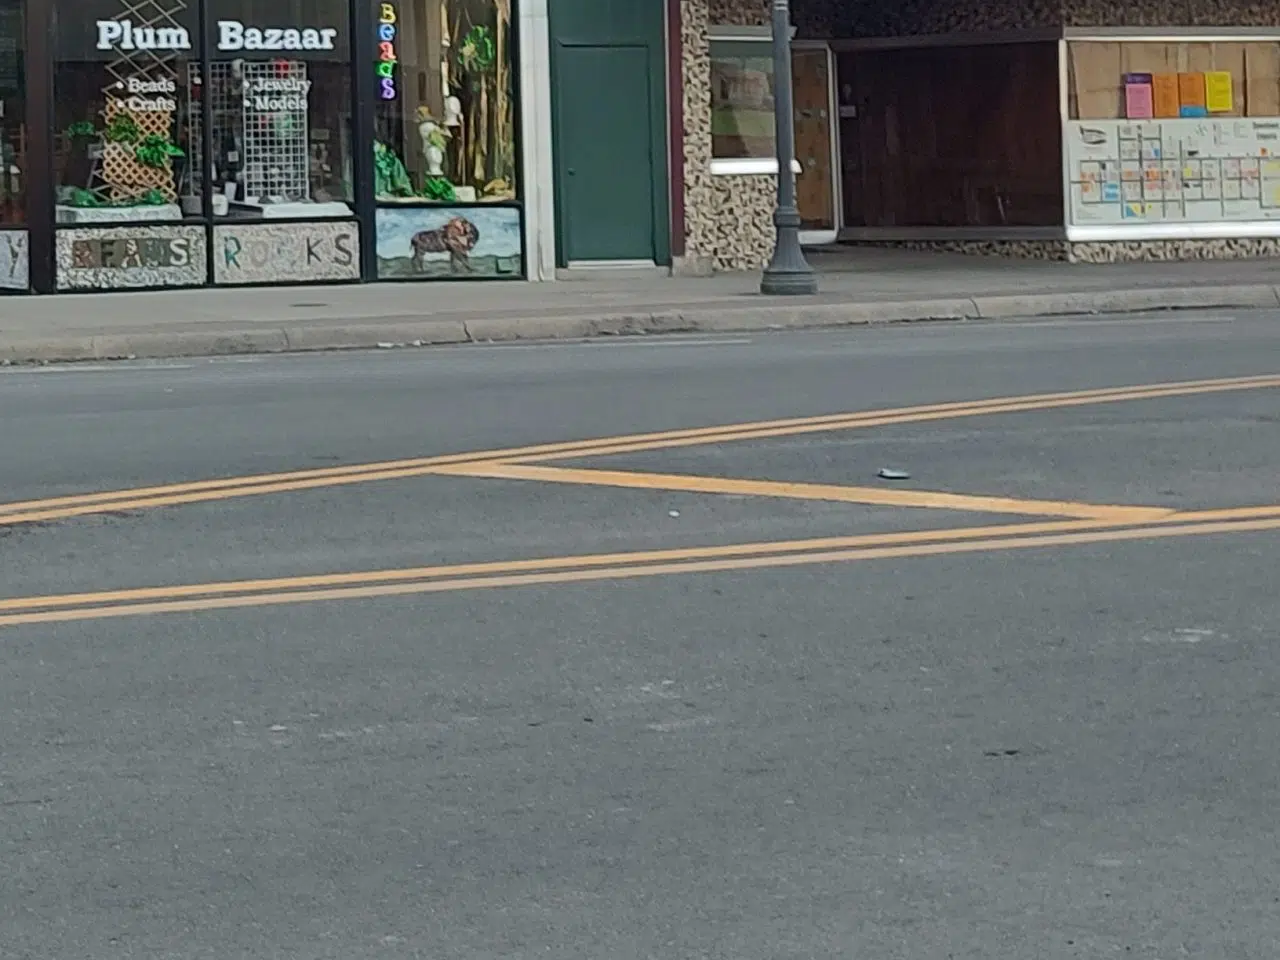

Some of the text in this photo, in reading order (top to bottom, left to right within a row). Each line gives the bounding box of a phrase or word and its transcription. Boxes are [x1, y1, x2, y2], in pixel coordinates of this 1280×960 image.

[96, 19, 337, 50] Plum Bazaar
[376, 3, 397, 100] Beads
[127, 78, 176, 93] Beads
[253, 77, 312, 95] Jewelry
[128, 96, 177, 112] Crafts
[255, 95, 309, 111] Models
